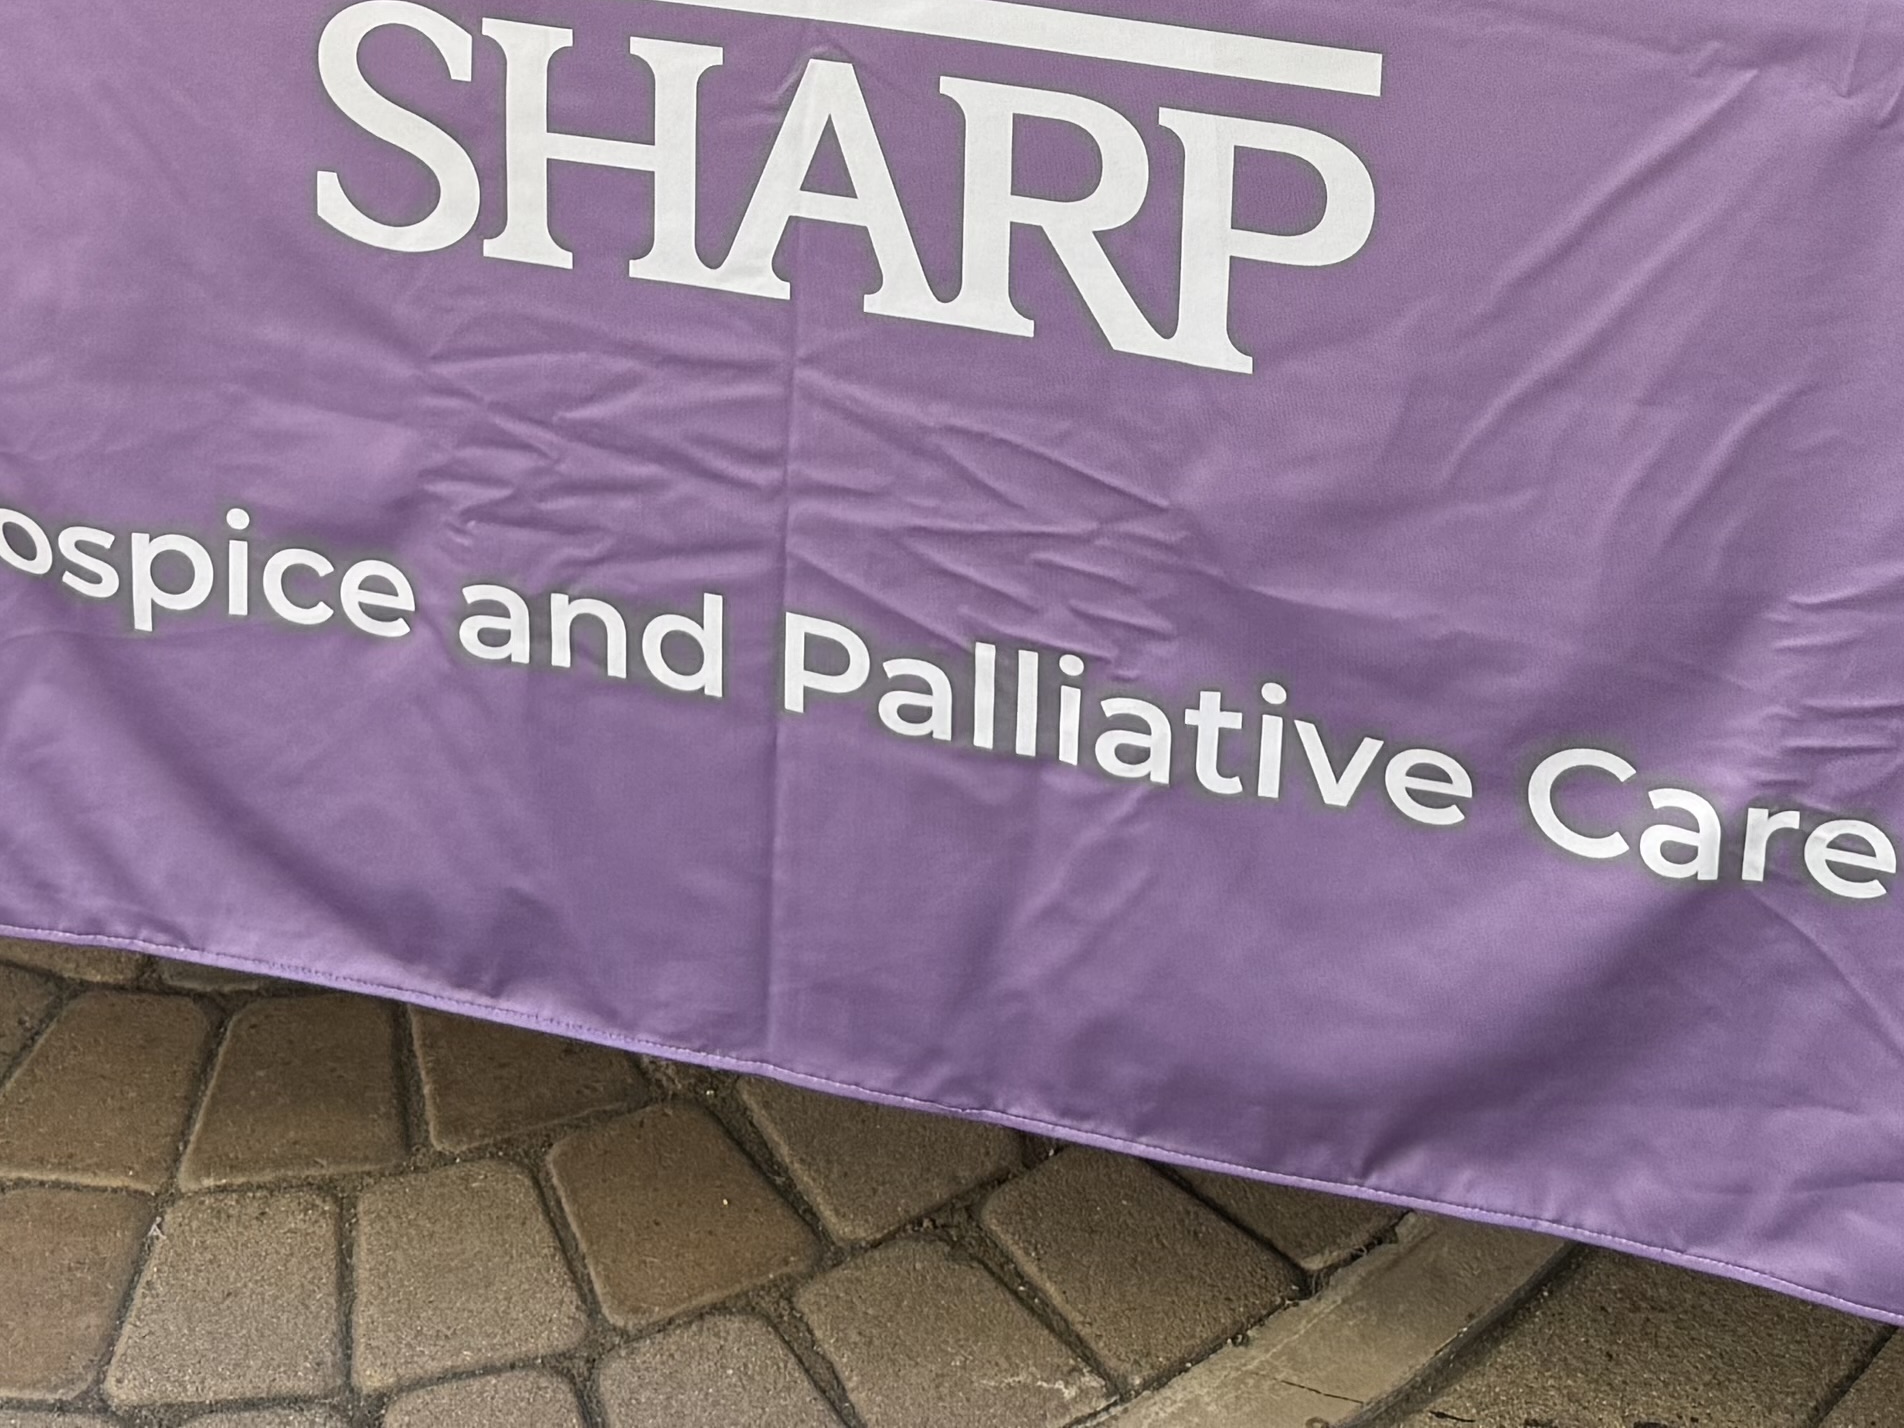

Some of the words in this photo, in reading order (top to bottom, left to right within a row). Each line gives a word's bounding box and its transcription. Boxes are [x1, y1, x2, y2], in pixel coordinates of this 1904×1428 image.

[317, 0, 1375, 374] SHARP
[459, 581, 724, 699] and
[784, 610, 1474, 827] Palliative
[1528, 747, 1898, 900] Care
